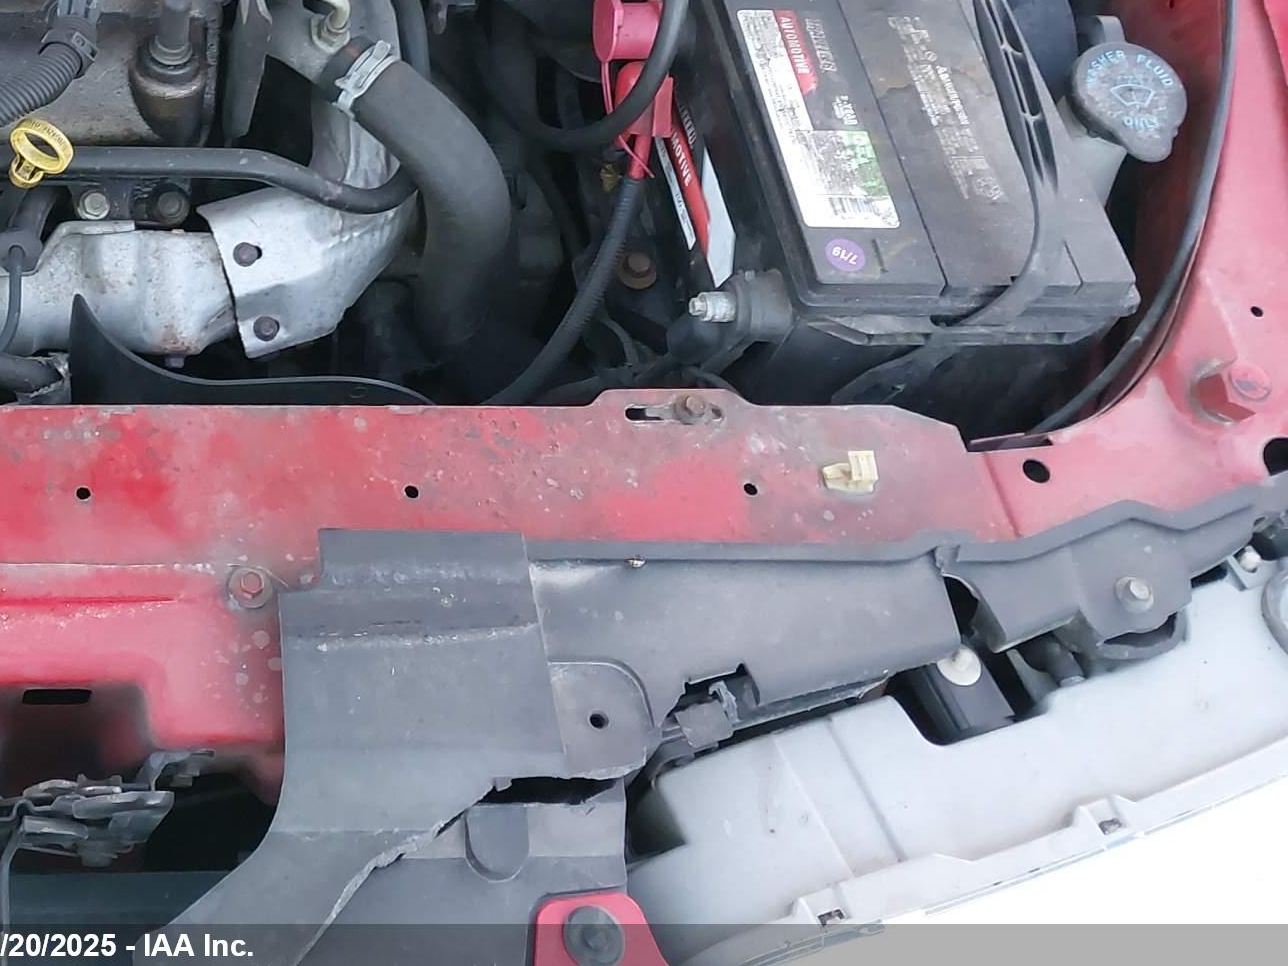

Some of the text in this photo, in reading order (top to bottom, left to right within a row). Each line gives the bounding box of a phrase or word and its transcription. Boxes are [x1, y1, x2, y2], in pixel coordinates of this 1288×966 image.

[780, 17, 810, 74] AUTOMOTIVE
[1086, 50, 1173, 87] WASHER FLUID
[832, 246, 858, 265] 7/19
